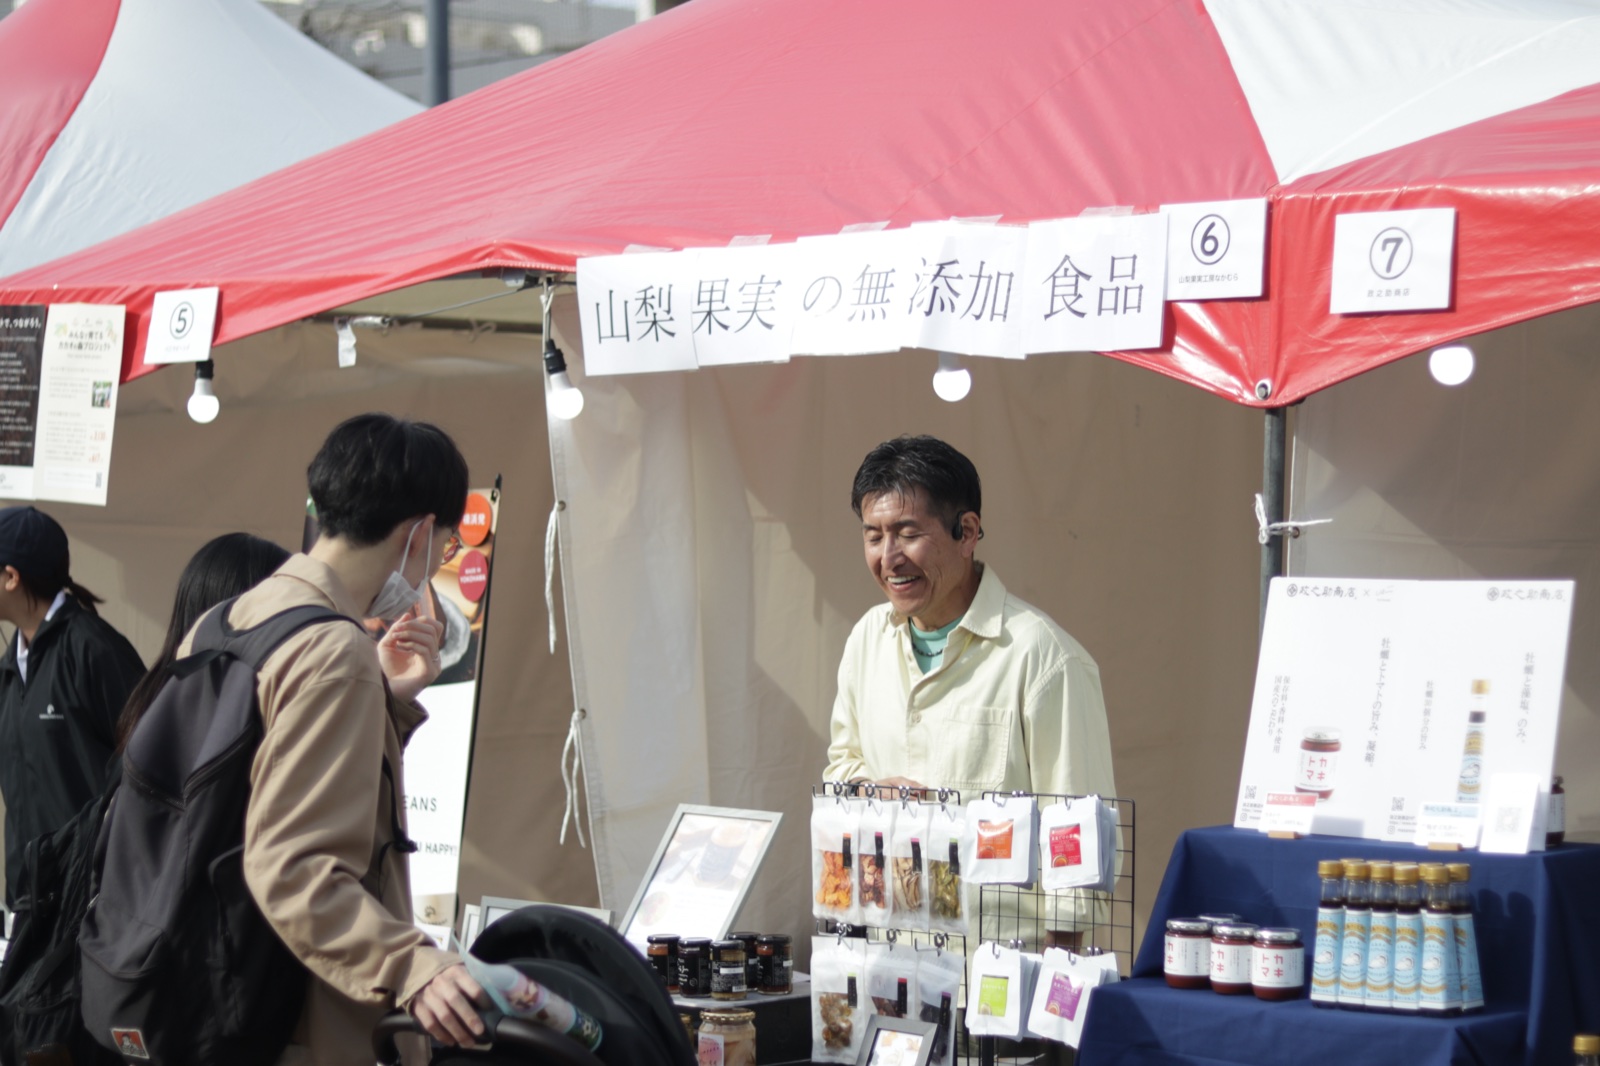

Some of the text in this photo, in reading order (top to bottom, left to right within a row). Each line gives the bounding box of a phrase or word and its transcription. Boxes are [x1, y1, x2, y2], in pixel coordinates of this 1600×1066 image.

[1178, 273, 1239, 284] 山梨果実工房なかむら
